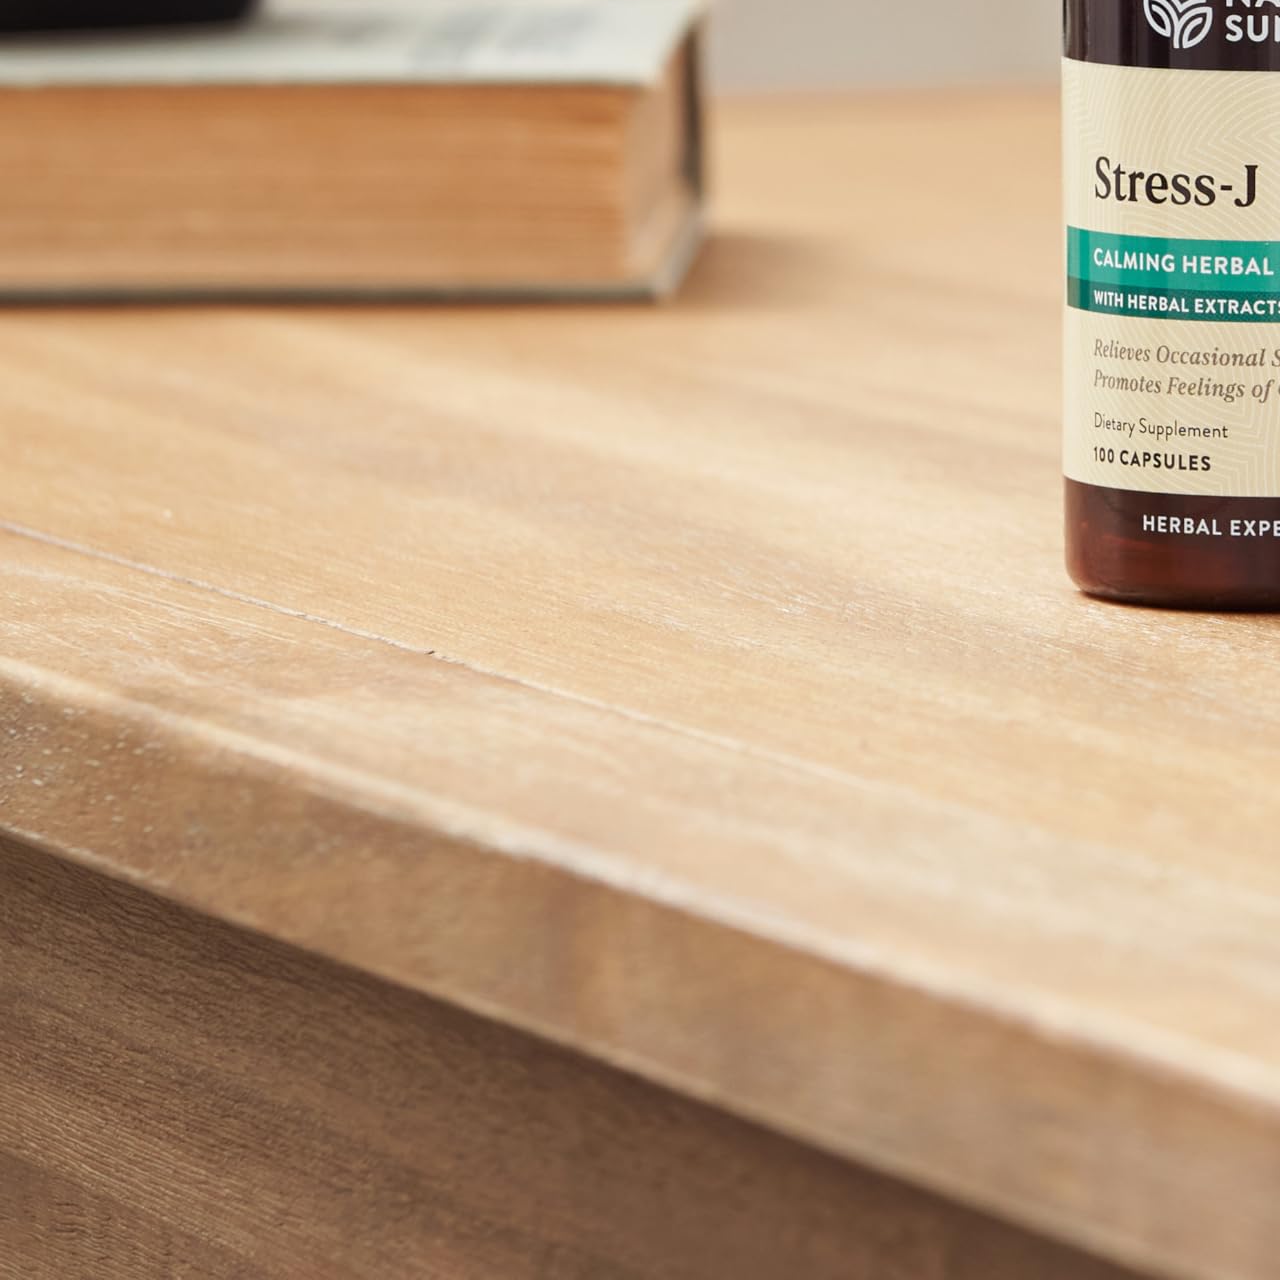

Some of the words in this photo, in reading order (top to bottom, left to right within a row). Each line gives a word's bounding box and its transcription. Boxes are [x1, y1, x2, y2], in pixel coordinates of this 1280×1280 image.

[1094, 156, 1259, 207] Stress-J
[1093, 248, 1175, 273] CALMING
[1182, 257, 1274, 276] HERBAL
[1093, 290, 1124, 308] WITH
[1127, 293, 1189, 314] HERBAL
[1093, 339, 1151, 363] Relieves
[1156, 345, 1266, 367] Occasional
[1093, 370, 1162, 394] Promotes
[1166, 376, 1245, 403] Feelings
[1251, 378, 1271, 403] of
[1094, 413, 1136, 439] Dietary
[1138, 418, 1229, 441] Supplement
[1093, 446, 1115, 465] 100
[1119, 450, 1211, 472] CAPSULES
[1142, 514, 1222, 537] HERBAL
